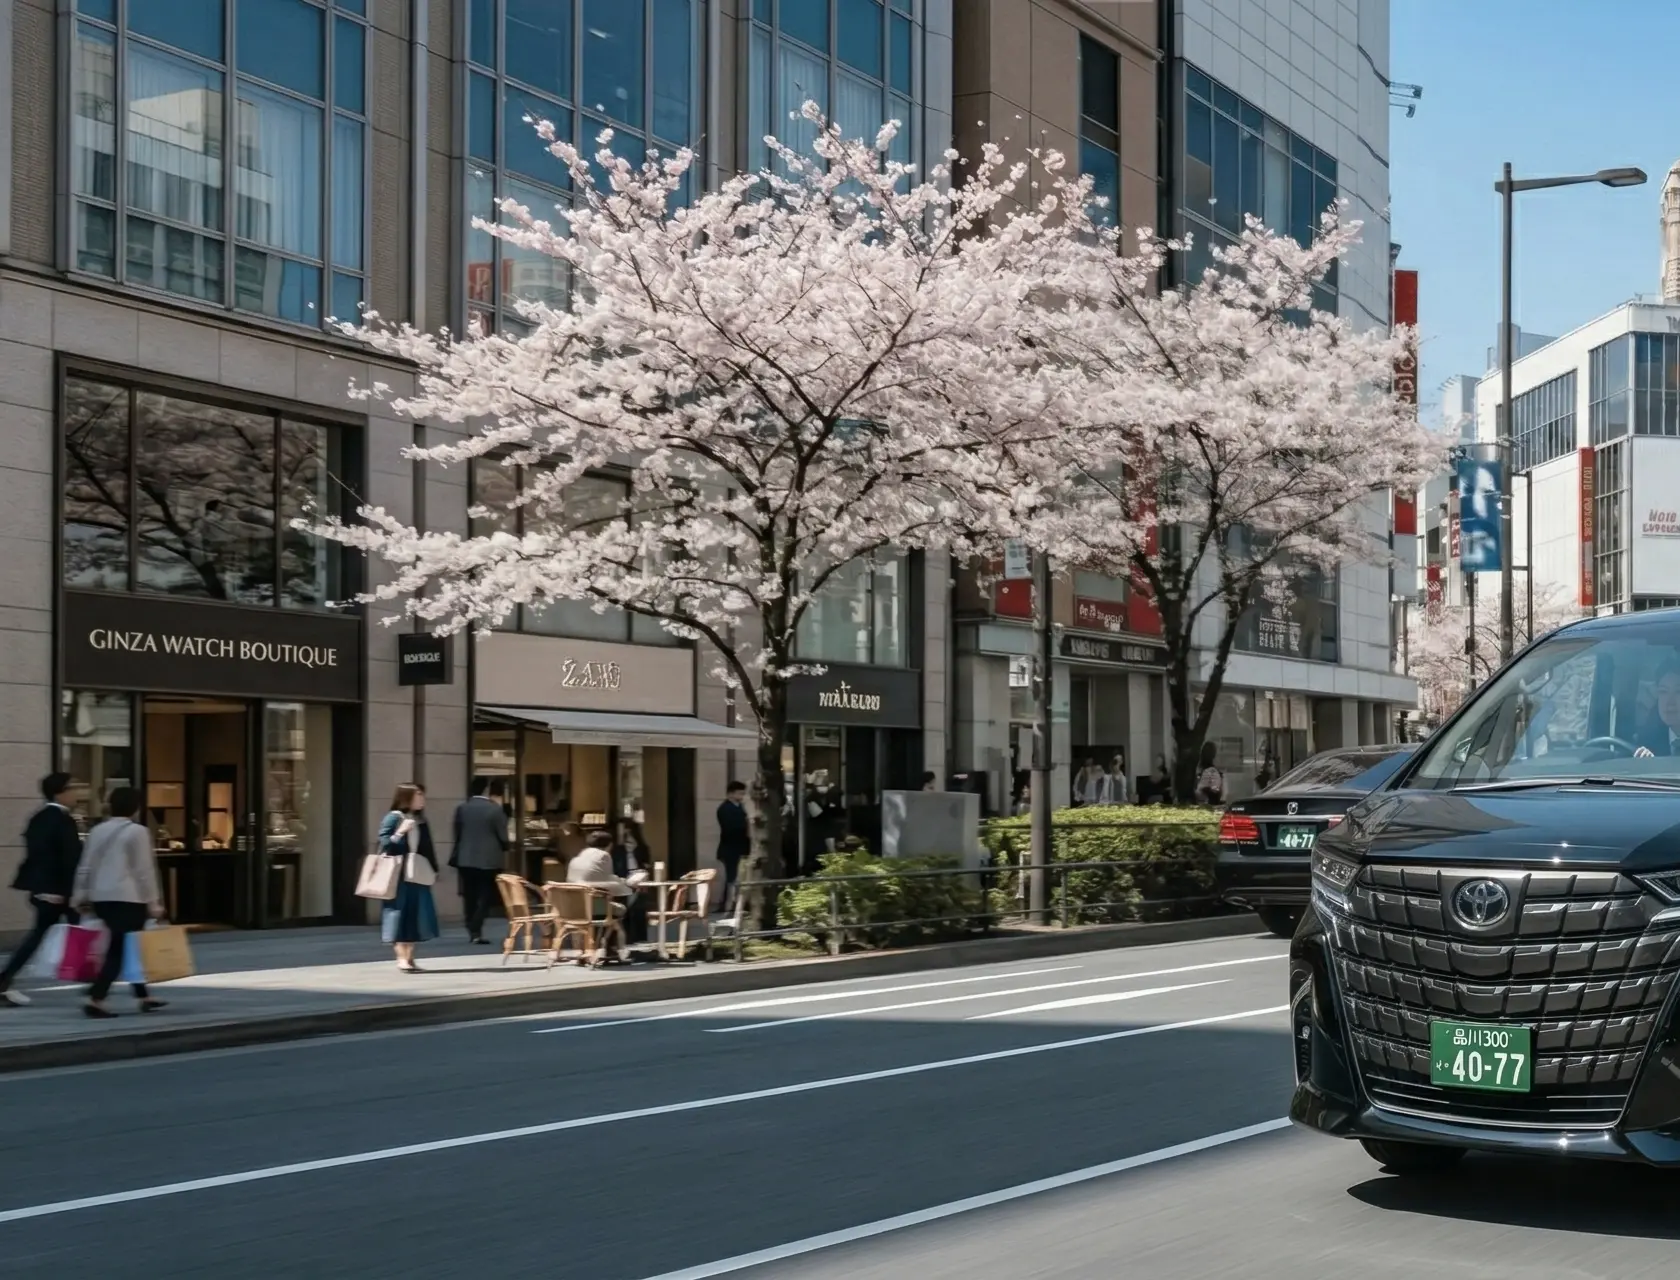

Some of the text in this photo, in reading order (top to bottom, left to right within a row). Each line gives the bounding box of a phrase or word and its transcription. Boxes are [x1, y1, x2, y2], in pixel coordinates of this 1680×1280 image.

[89, 628, 338, 668] GINZA WATCH BOUTIQUE
